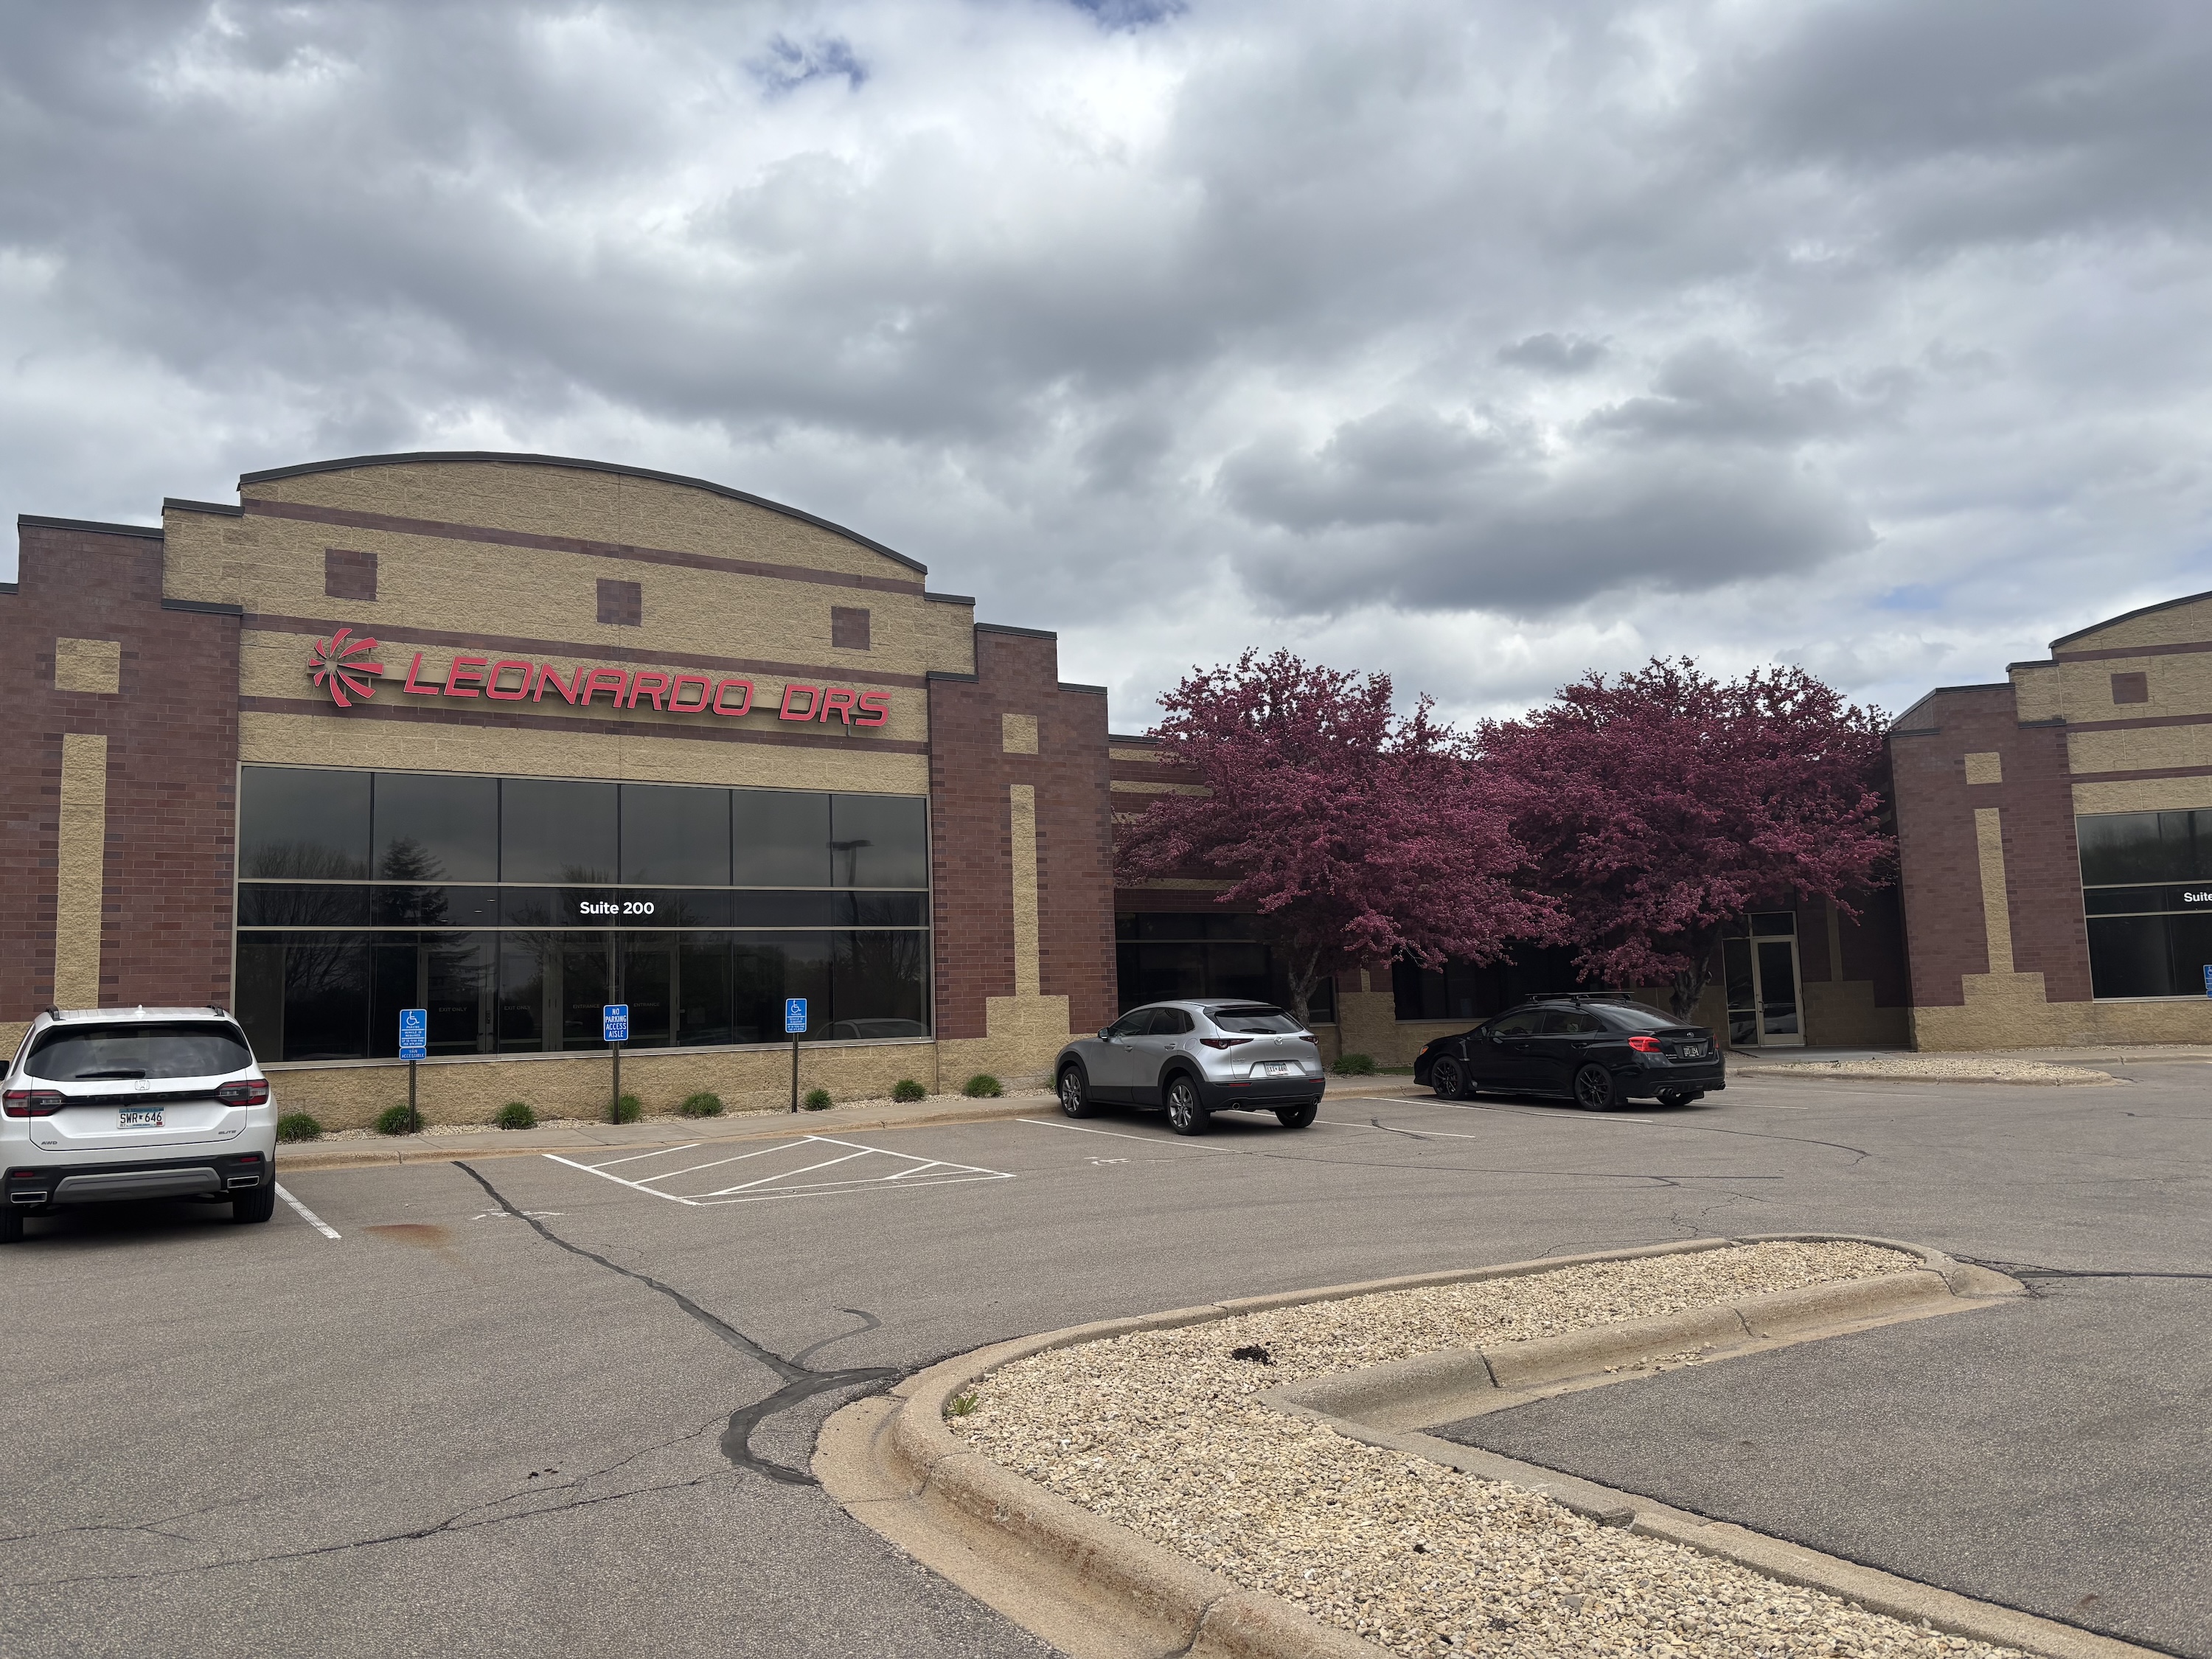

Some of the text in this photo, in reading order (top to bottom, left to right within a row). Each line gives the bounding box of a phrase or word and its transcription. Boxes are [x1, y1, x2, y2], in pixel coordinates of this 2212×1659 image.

[403, 652, 891, 727] LEONARDO DRS
[2183, 891, 2212, 902] Suite
[580, 901, 655, 914] Suite 200
[120, 1112, 162, 1124] SWR 646
